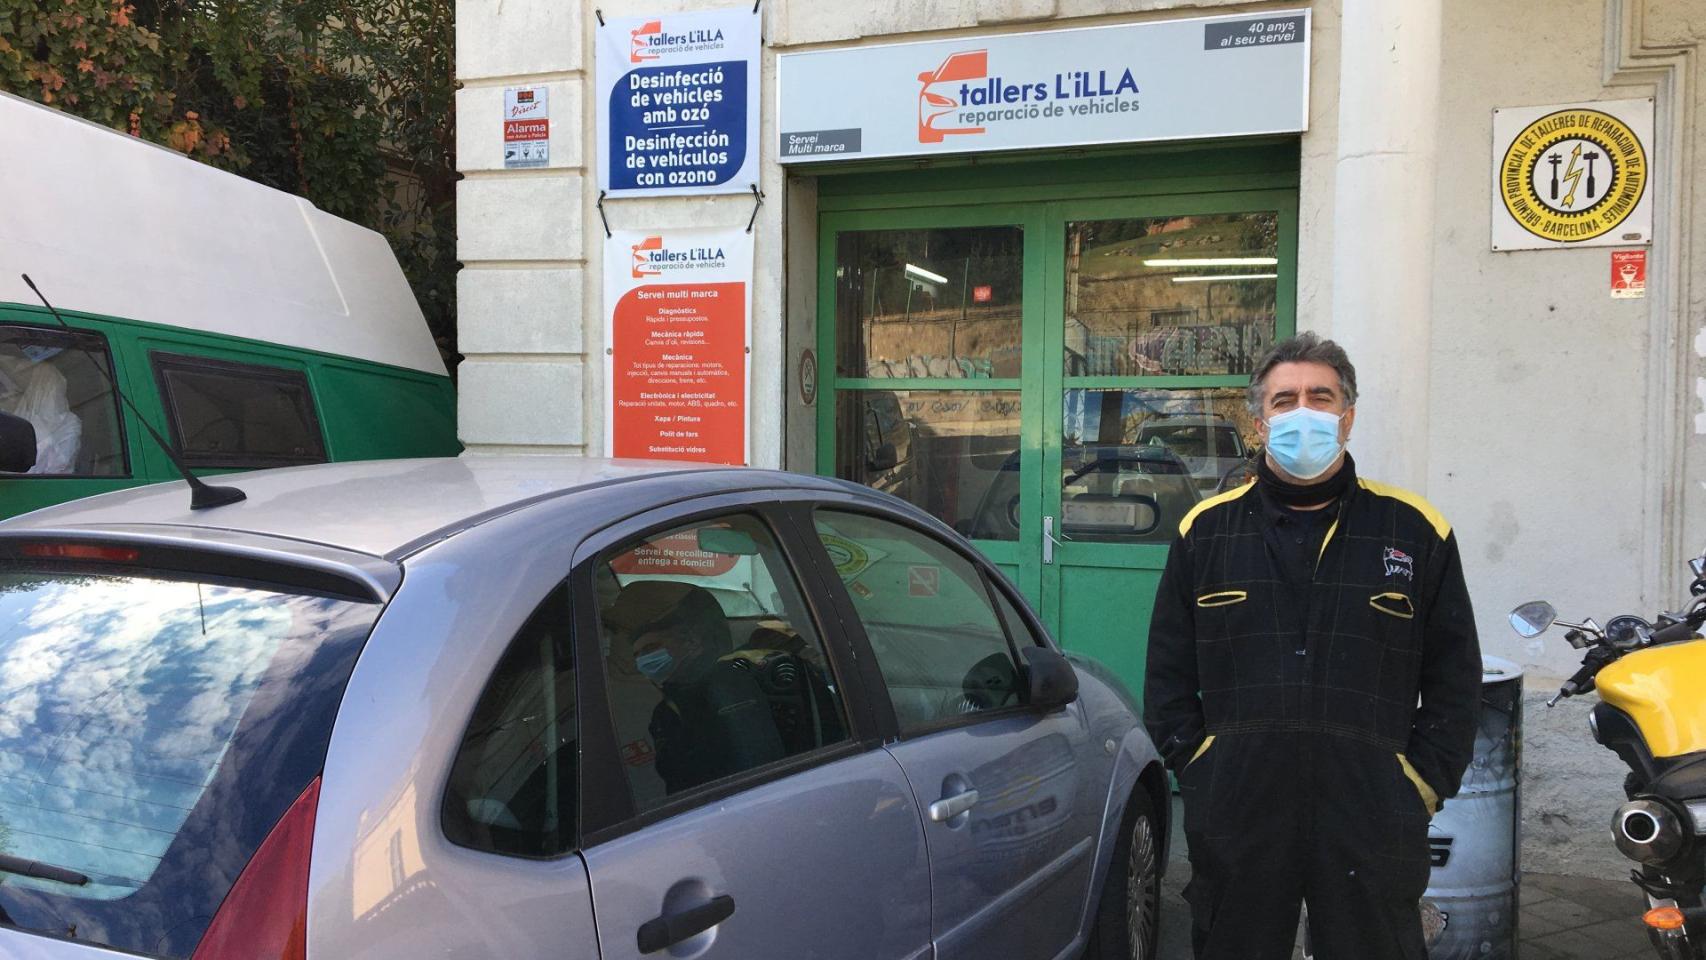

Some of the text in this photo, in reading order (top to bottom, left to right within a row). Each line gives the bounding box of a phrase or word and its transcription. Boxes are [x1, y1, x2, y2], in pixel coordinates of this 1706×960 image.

[1248, 21, 1295, 33] 40 anys
[649, 32, 687, 46] tallers
[1220, 30, 1296, 47] al seu servei
[648, 42, 725, 55] reparació de vehicles
[630, 66, 724, 90] Desinfecció
[959, 67, 1140, 106] tallers L'iLLA
[631, 87, 723, 107] de vehicles
[643, 103, 710, 124] amb ozó
[959, 97, 1140, 126] reparació de vehicles
[507, 122, 546, 135] Alarma
[625, 130, 729, 151] Desinfección
[788, 133, 819, 145] Servei
[788, 143, 846, 155] Multi marca
[626, 149, 728, 168] de vehículos
[1506, 114, 1641, 227] GREMIO PROVINCIAL DE TALLERES DE REPARACION DE AUTOMOVILES
[636, 170, 716, 185] con ozono
[1542, 219, 1601, 237] BARCELONA
[649, 249, 688, 262] tallers
[649, 262, 685, 272] reparació
[695, 260, 726, 268] vehicles
[637, 289, 719, 300] Servei multi marca
[675, 430, 685, 438] de
[686, 445, 706, 453] vidres
[634, 547, 661, 556] Servei
[663, 548, 674, 557] de
[638, 557, 671, 567] entrega
[680, 558, 715, 568] domicili
